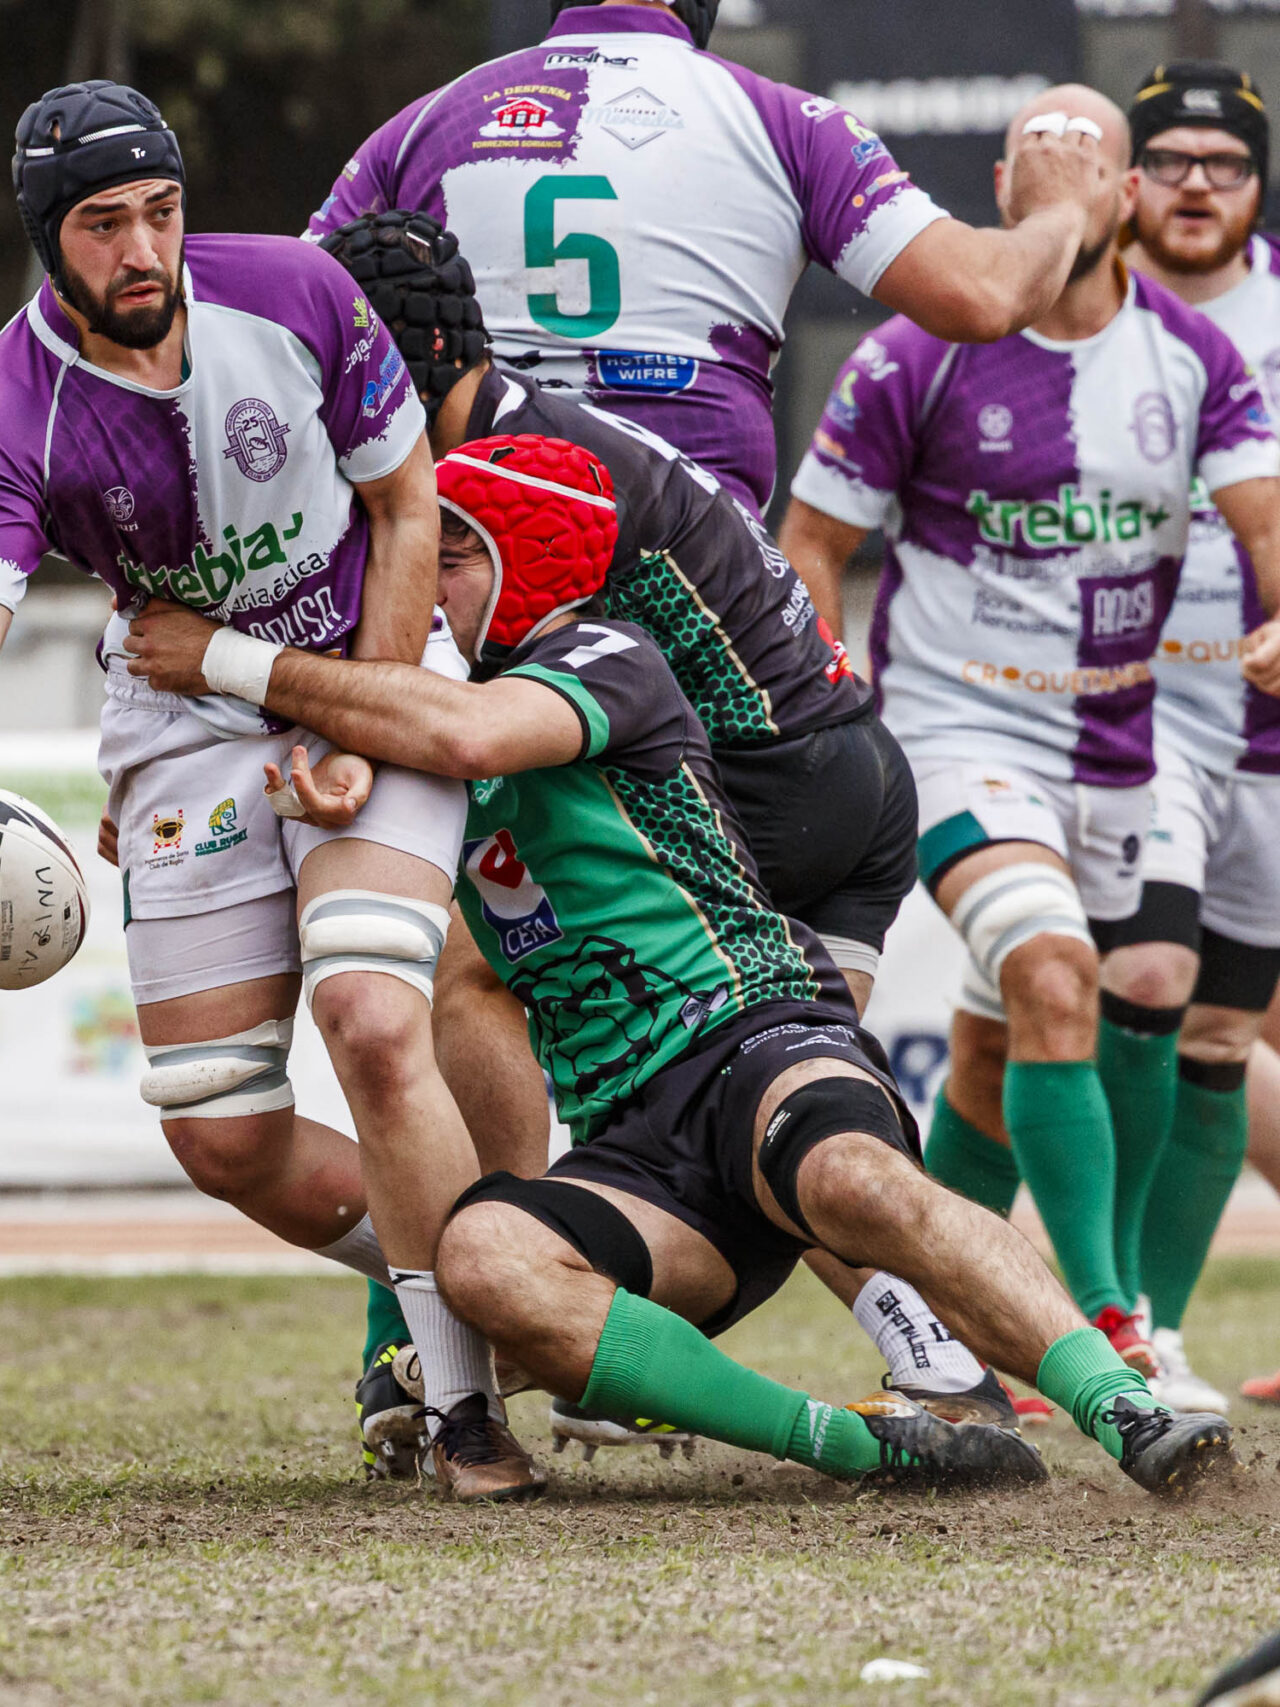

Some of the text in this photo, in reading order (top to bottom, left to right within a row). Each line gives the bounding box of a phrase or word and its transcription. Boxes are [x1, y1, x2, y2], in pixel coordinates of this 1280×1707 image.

[504, 85, 572, 101] DESPENSA
[524, 175, 621, 338] 5
[607, 353, 688, 368] HOTELES
[618, 367, 679, 380] WIFRE
[242, 415, 259, 432] 25
[558, 623, 640, 669] 7
[506, 917, 555, 955] CEFA
